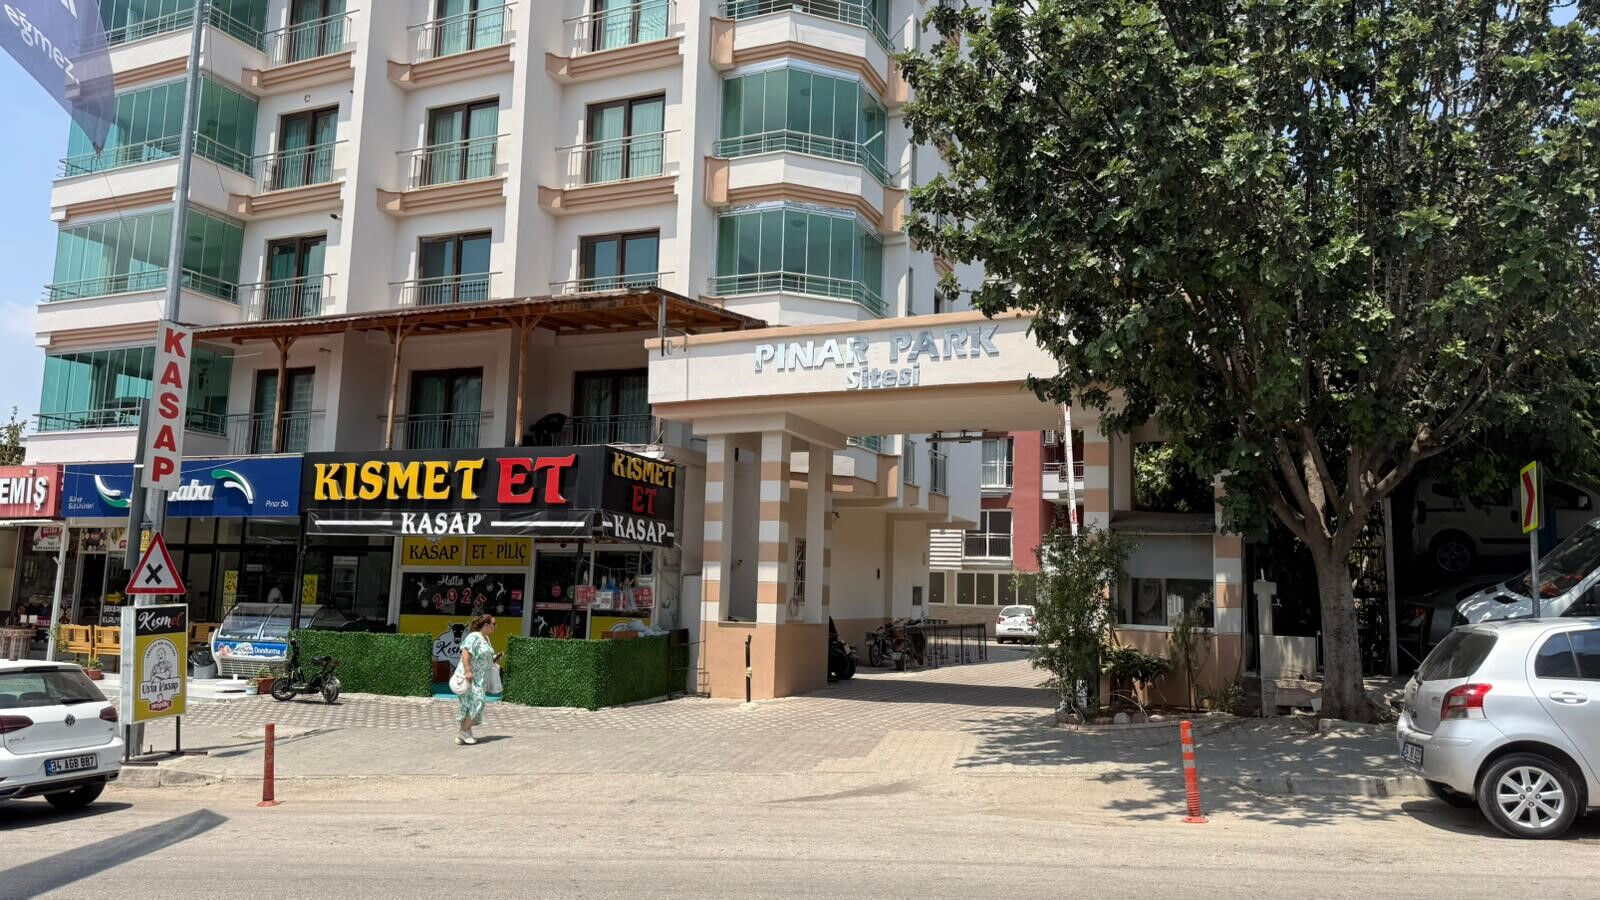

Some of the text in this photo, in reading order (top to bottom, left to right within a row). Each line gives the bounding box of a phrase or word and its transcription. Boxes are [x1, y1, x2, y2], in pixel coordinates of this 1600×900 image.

[754, 324, 1000, 376] PINAR PARK
[847, 362, 921, 391] Sitesi
[152, 327, 187, 483] KASAP
[314, 453, 577, 504] KISMET ET
[613, 452, 676, 489] KISMET
[632, 484, 657, 515] ET
[400, 512, 482, 535] KASAP
[613, 514, 666, 544] KASAP
[409, 545, 459, 560] KASAP
[472, 544, 487, 559] ET
[496, 542, 527, 564] PİLİÇ
[51, 760, 62, 772] 34
